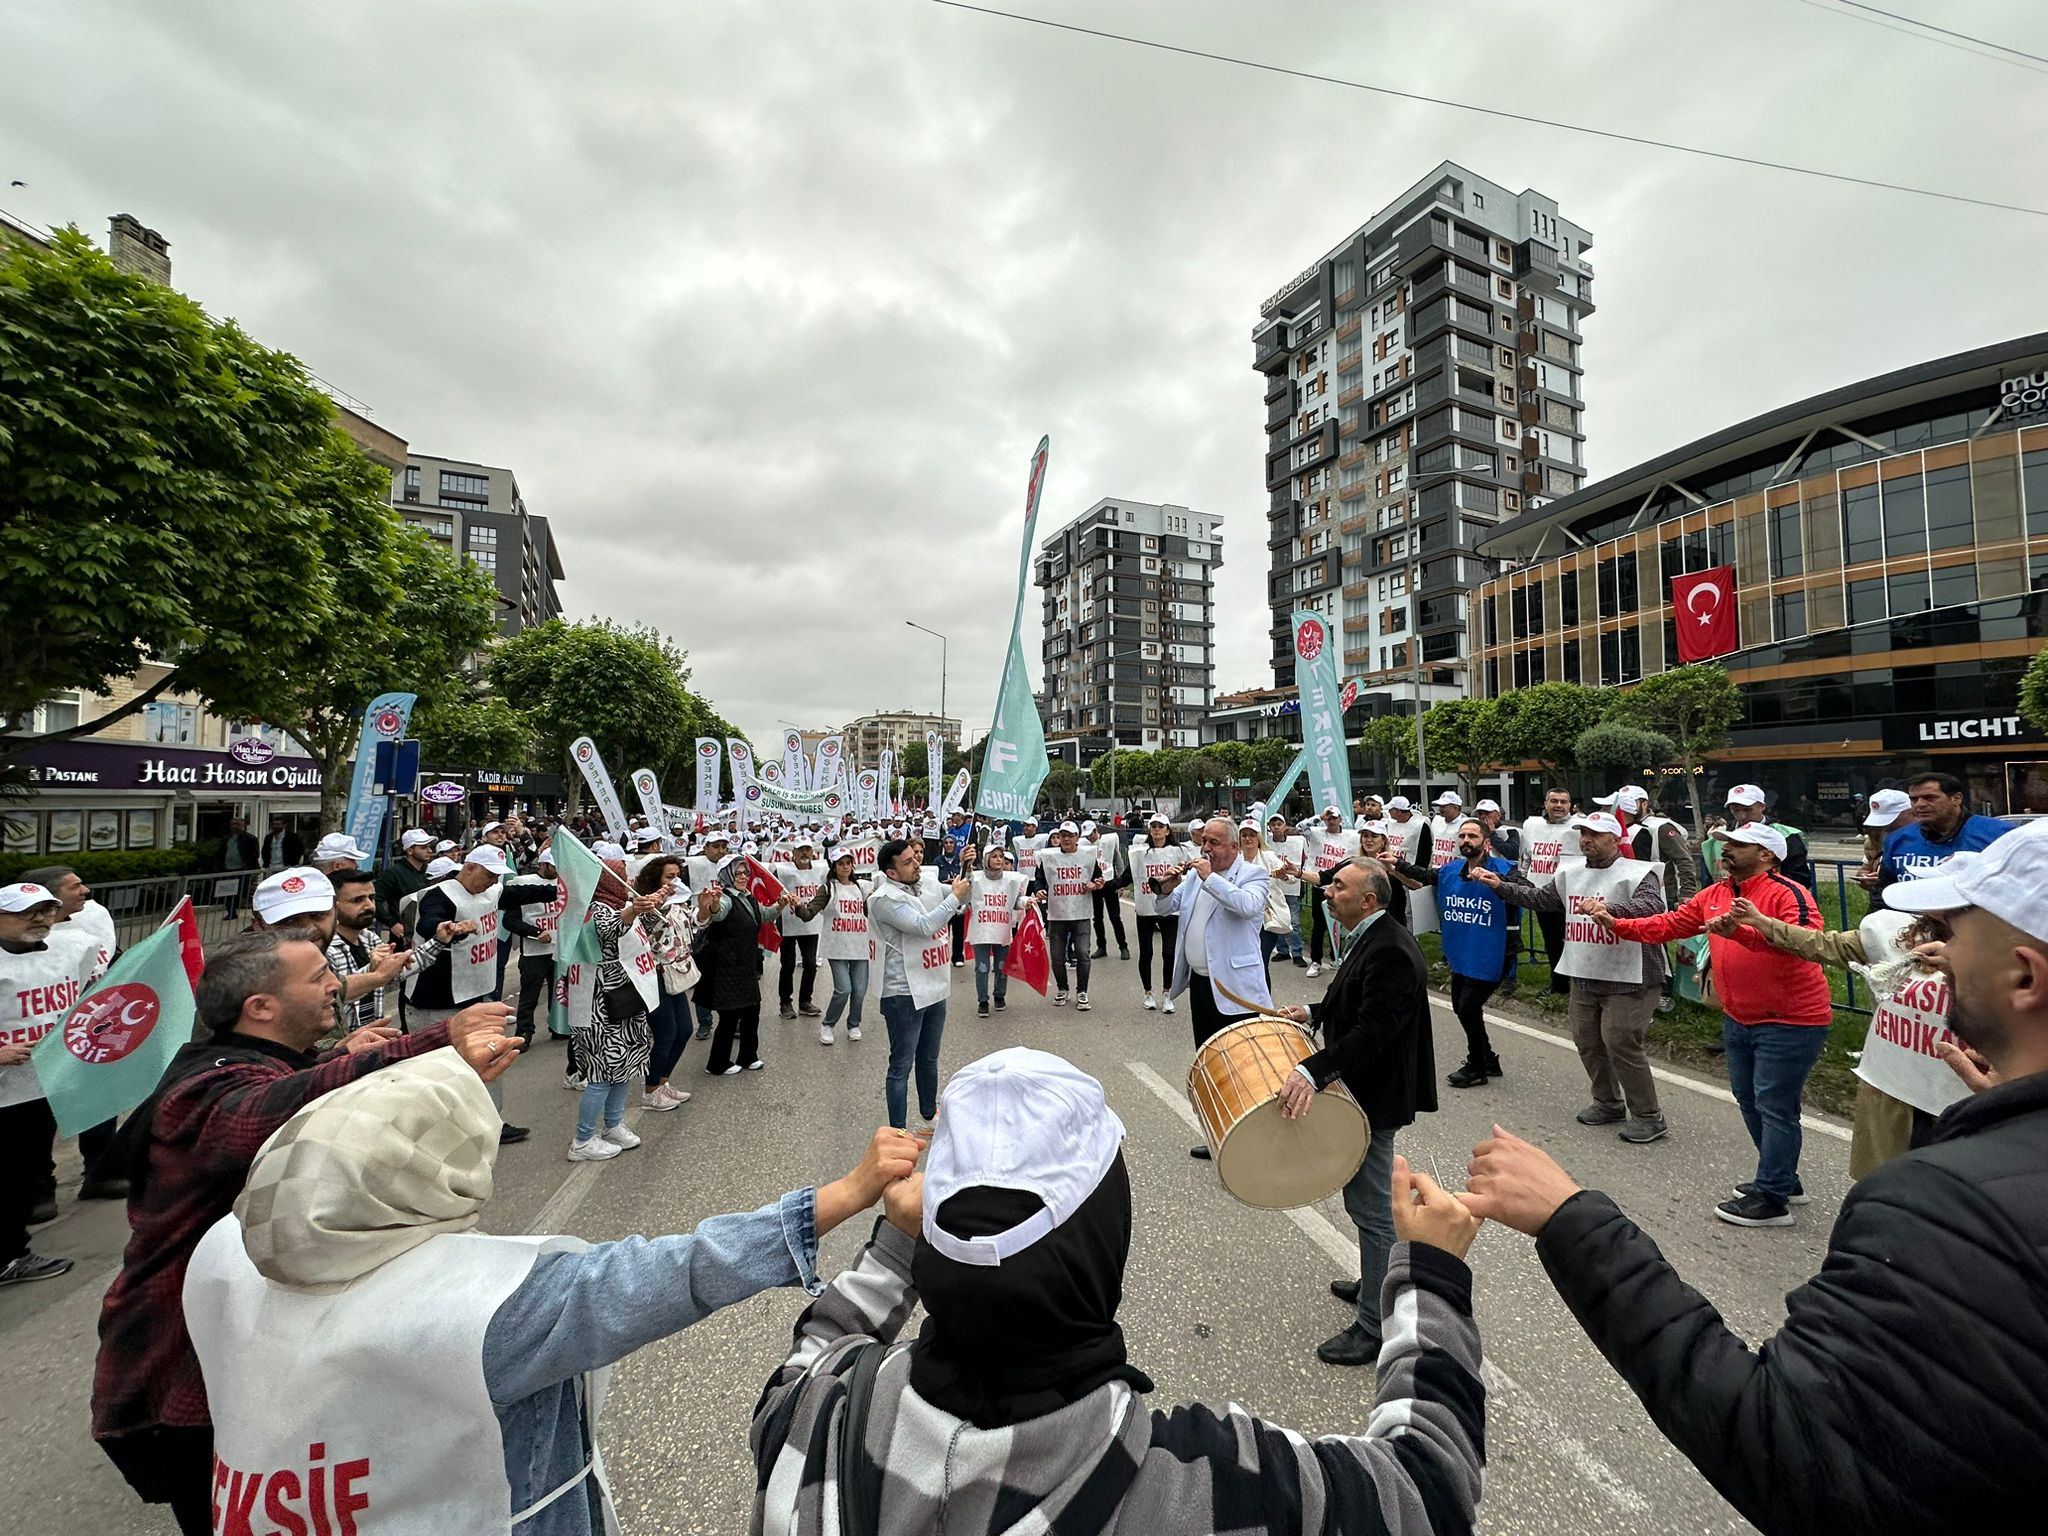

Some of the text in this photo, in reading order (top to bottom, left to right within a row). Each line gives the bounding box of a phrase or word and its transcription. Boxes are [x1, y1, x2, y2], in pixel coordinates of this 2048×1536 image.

[2000, 371, 2048, 394] mu
[138, 759, 322, 789] Hacı Hasan Oğulla
[761, 798, 824, 814] SUSURLUK ŞUBESİ
[850, 847, 875, 865] AYIS
[1323, 842, 1346, 859] TEKSİF
[1532, 840, 1562, 856] TEKSİF
[1892, 853, 1948, 868] TÜRK
[1056, 864, 1081, 880] TEKSİF
[984, 892, 1007, 907] TEKSİF
[1444, 909, 1492, 927] GÖREVLİ
[66, 1000, 110, 1063] TEKSİF
[211, 1441, 370, 1536] EKSİF
